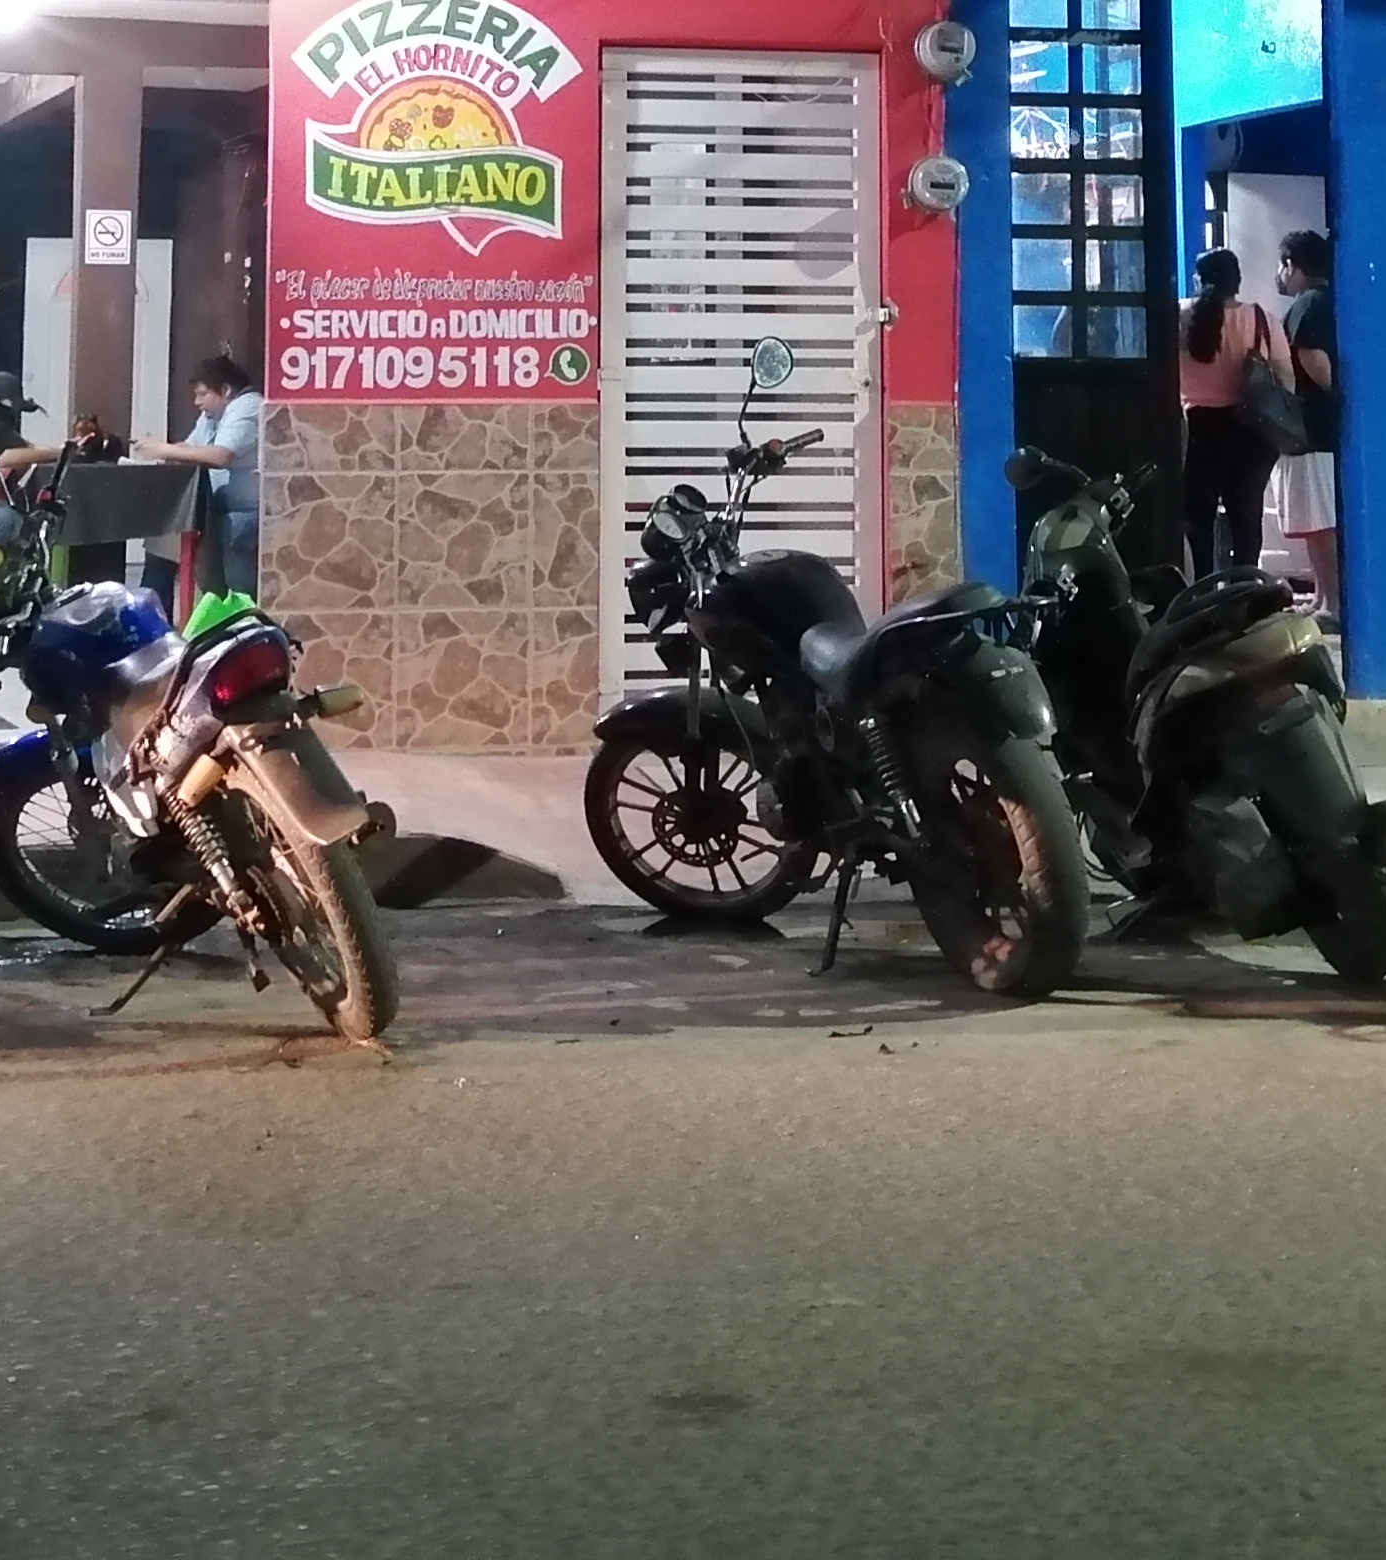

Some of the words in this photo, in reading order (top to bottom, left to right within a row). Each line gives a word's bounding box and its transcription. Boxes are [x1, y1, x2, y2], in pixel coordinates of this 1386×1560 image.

[353, 61, 396, 97] EL
[393, 43, 521, 98] HORNITO
[326, 155, 547, 208] ITALIANO
[292, 308, 429, 340] SERVICIO
[448, 307, 590, 340] DOMICILIO
[279, 345, 541, 391] 9171095118
